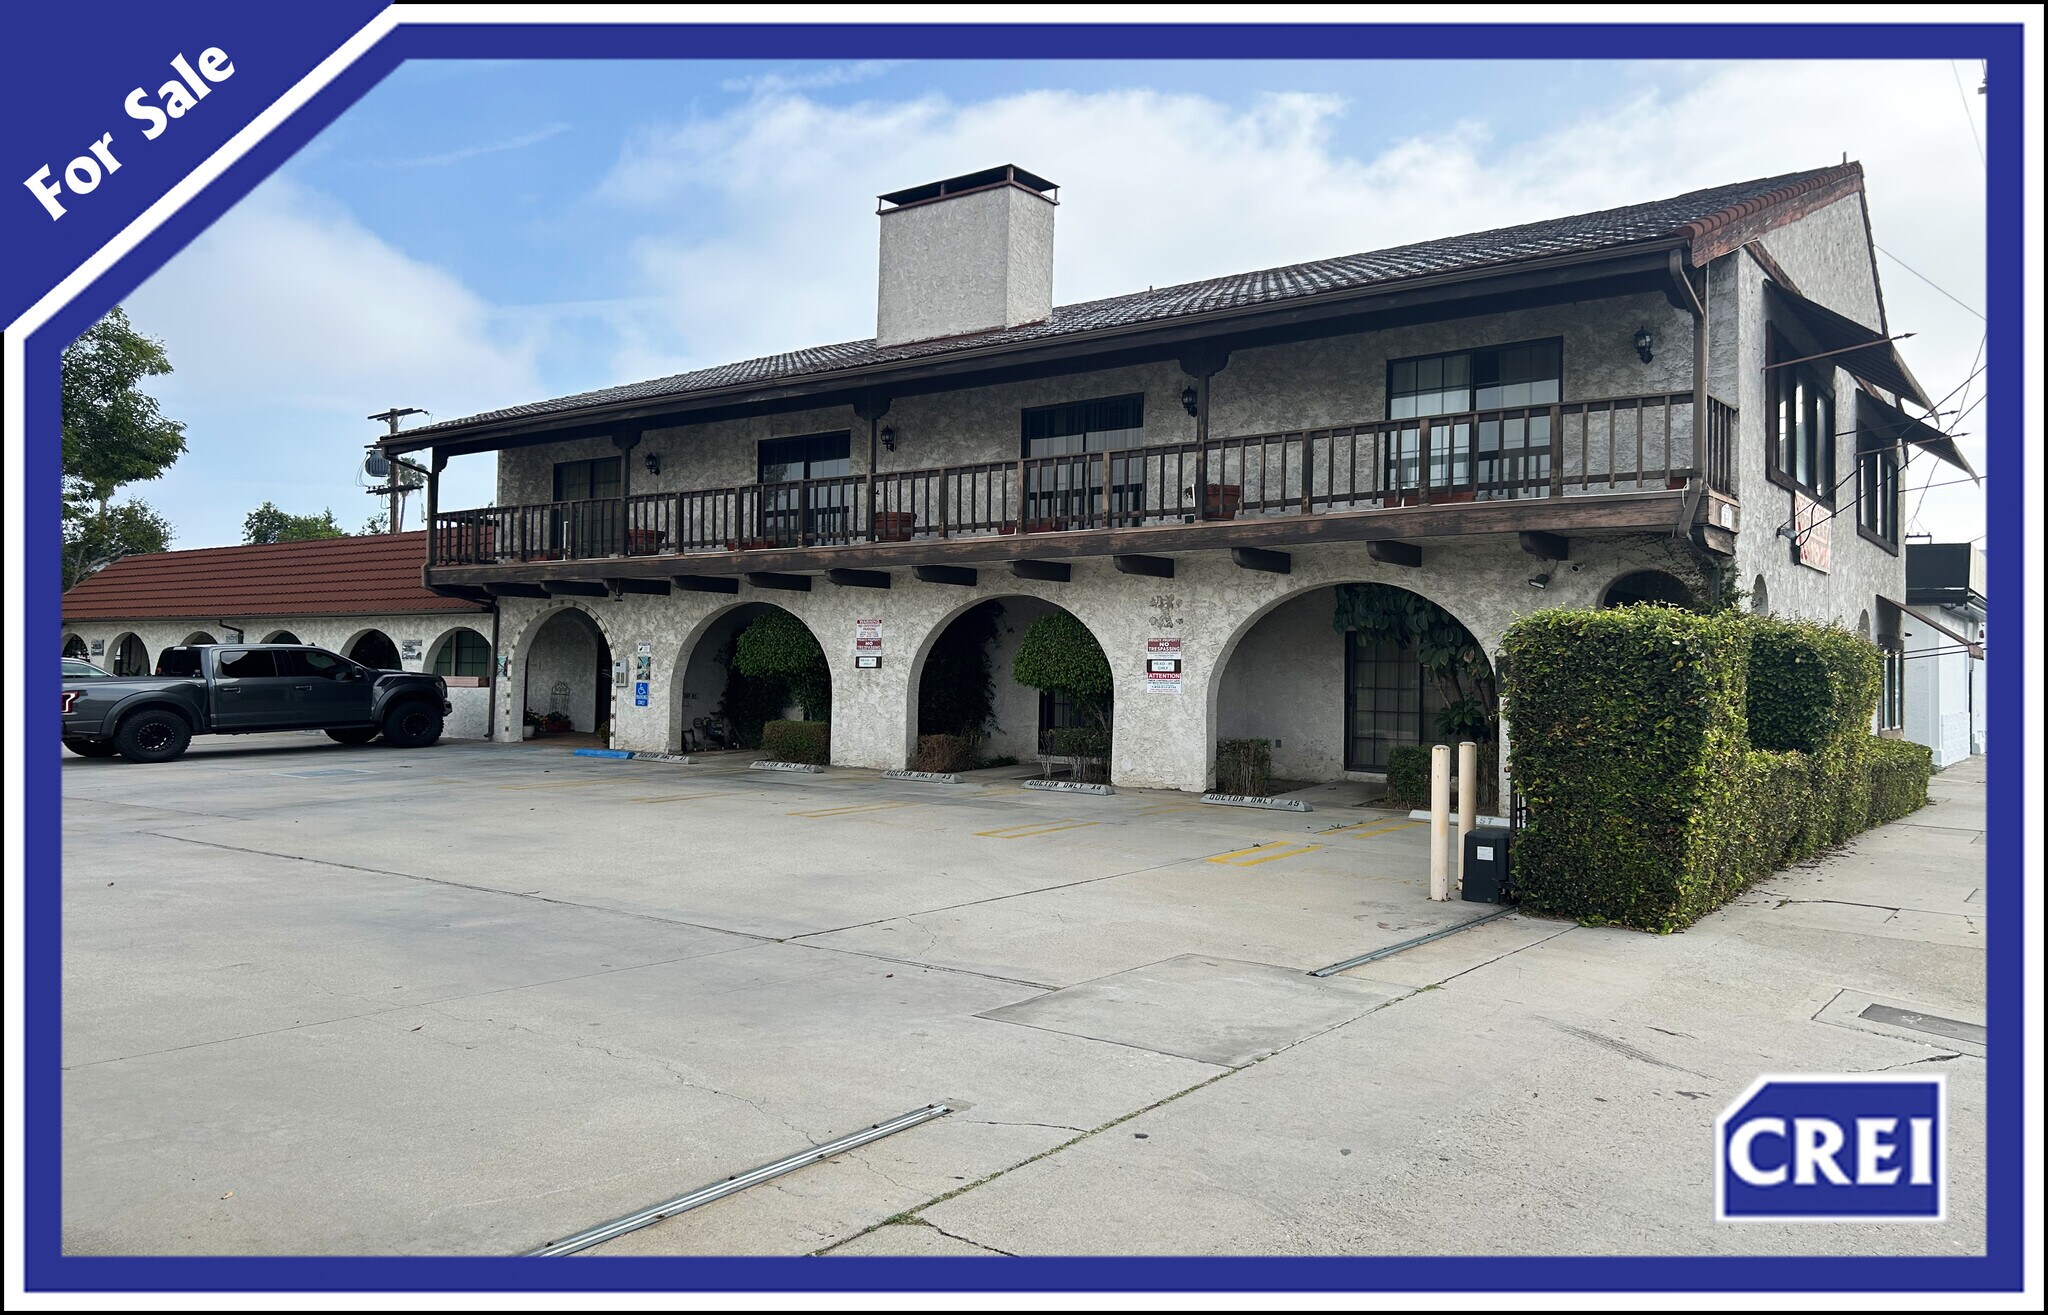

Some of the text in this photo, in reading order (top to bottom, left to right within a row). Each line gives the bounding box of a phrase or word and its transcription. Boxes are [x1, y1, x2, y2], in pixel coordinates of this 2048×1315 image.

[1208, 794, 1301, 807] DOCTOR ONLY A5
